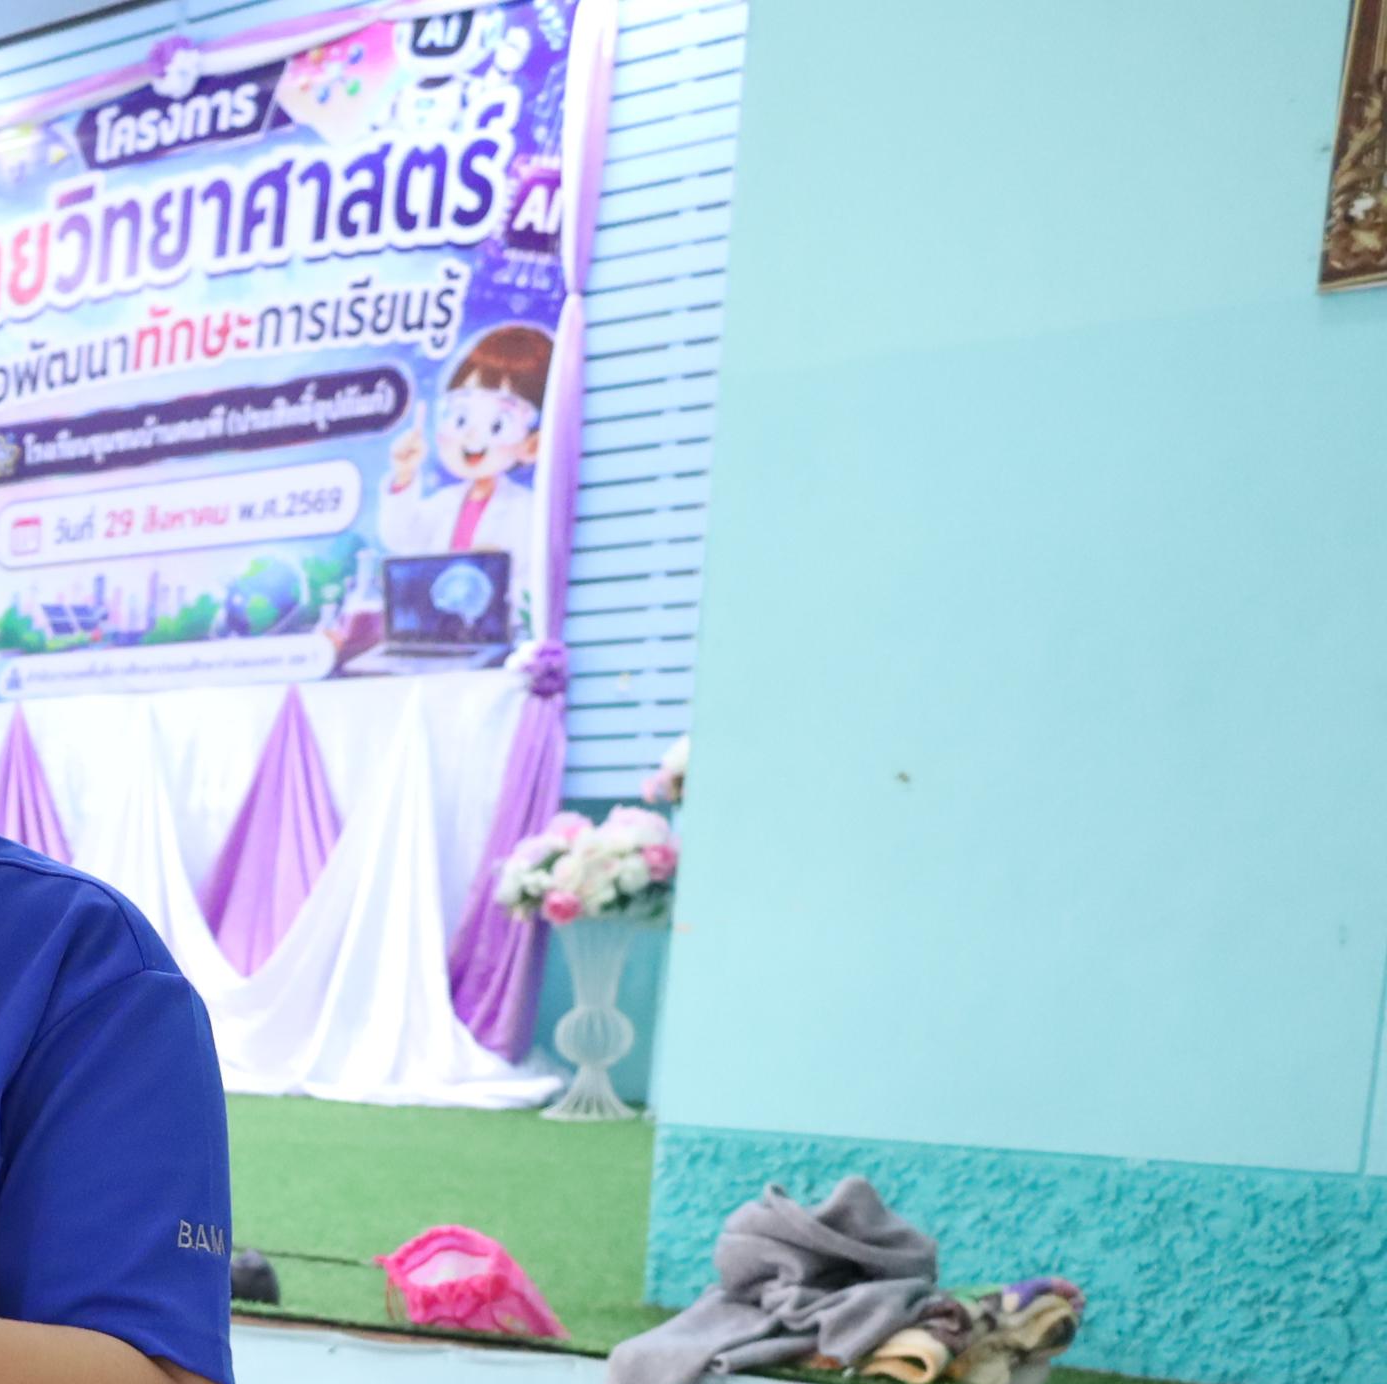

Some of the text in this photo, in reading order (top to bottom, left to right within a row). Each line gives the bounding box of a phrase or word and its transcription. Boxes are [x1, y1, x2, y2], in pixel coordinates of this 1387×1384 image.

[94, 84, 256, 165] โครงการ
[54, 508, 95, 544] วันที่
[104, 509, 134, 538] 29
[141, 503, 229, 534] สิงหาคม
